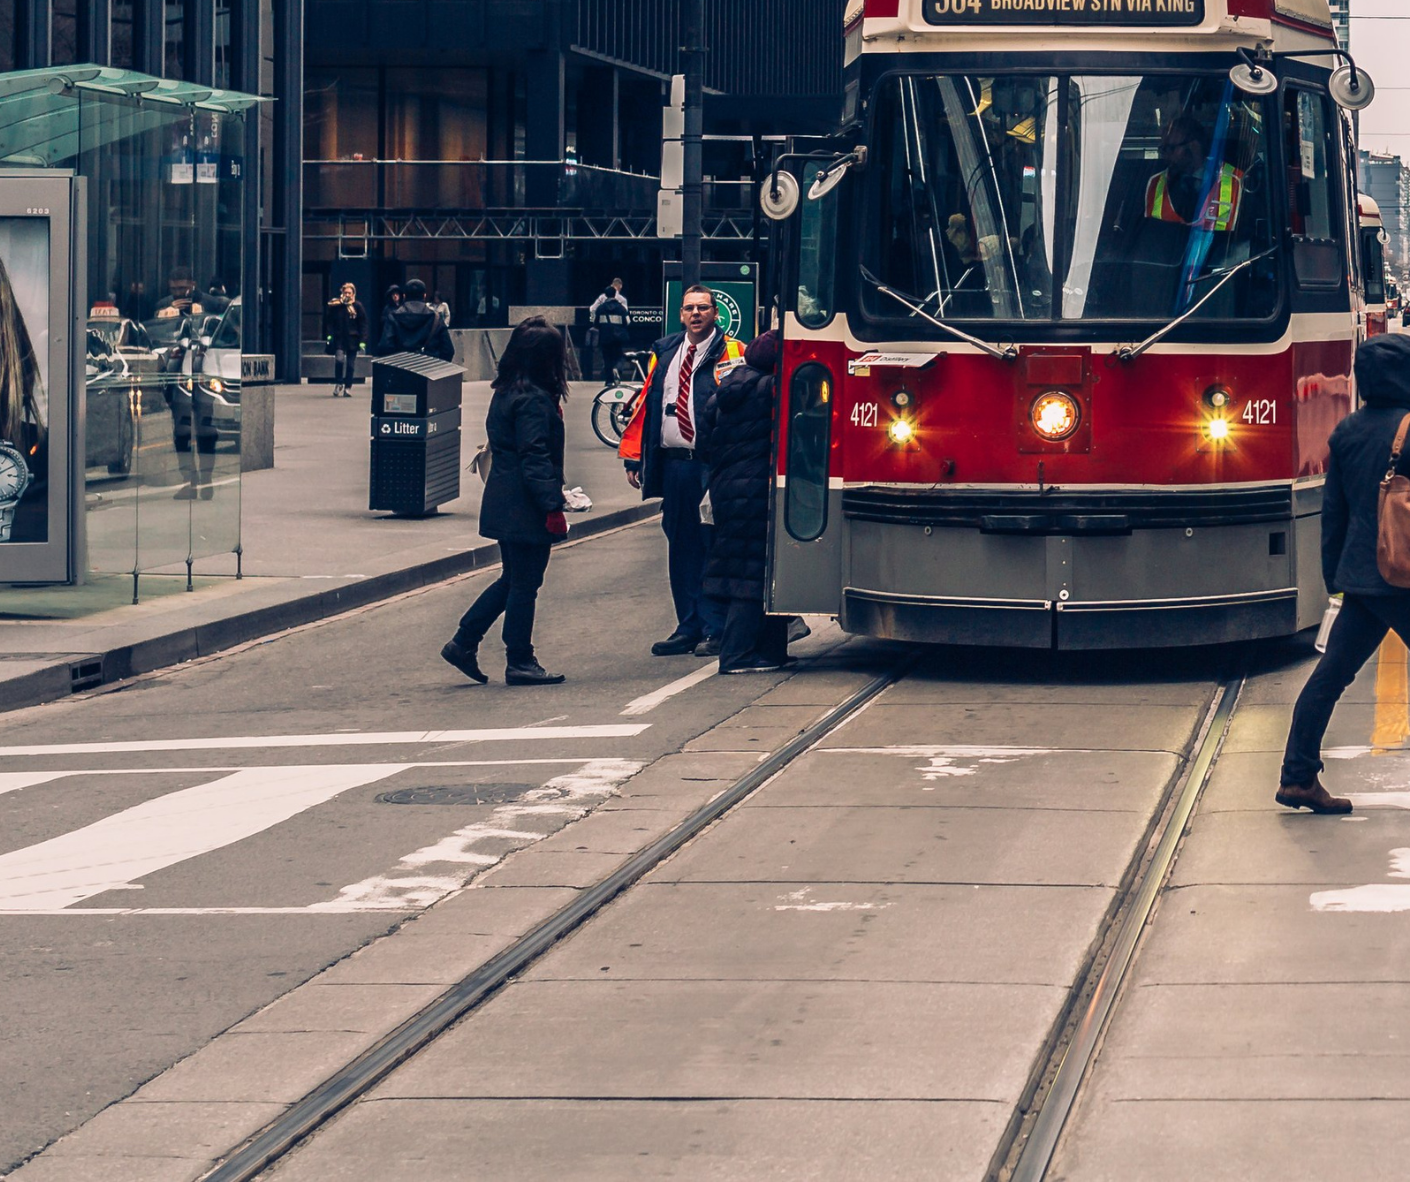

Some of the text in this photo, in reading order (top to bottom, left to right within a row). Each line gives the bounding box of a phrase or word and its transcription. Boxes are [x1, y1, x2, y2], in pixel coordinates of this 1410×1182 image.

[714, 292, 738, 315] HARE
[850, 402, 878, 427] 4121
[1242, 399, 1276, 424] 4121
[394, 421, 420, 434] Litter
